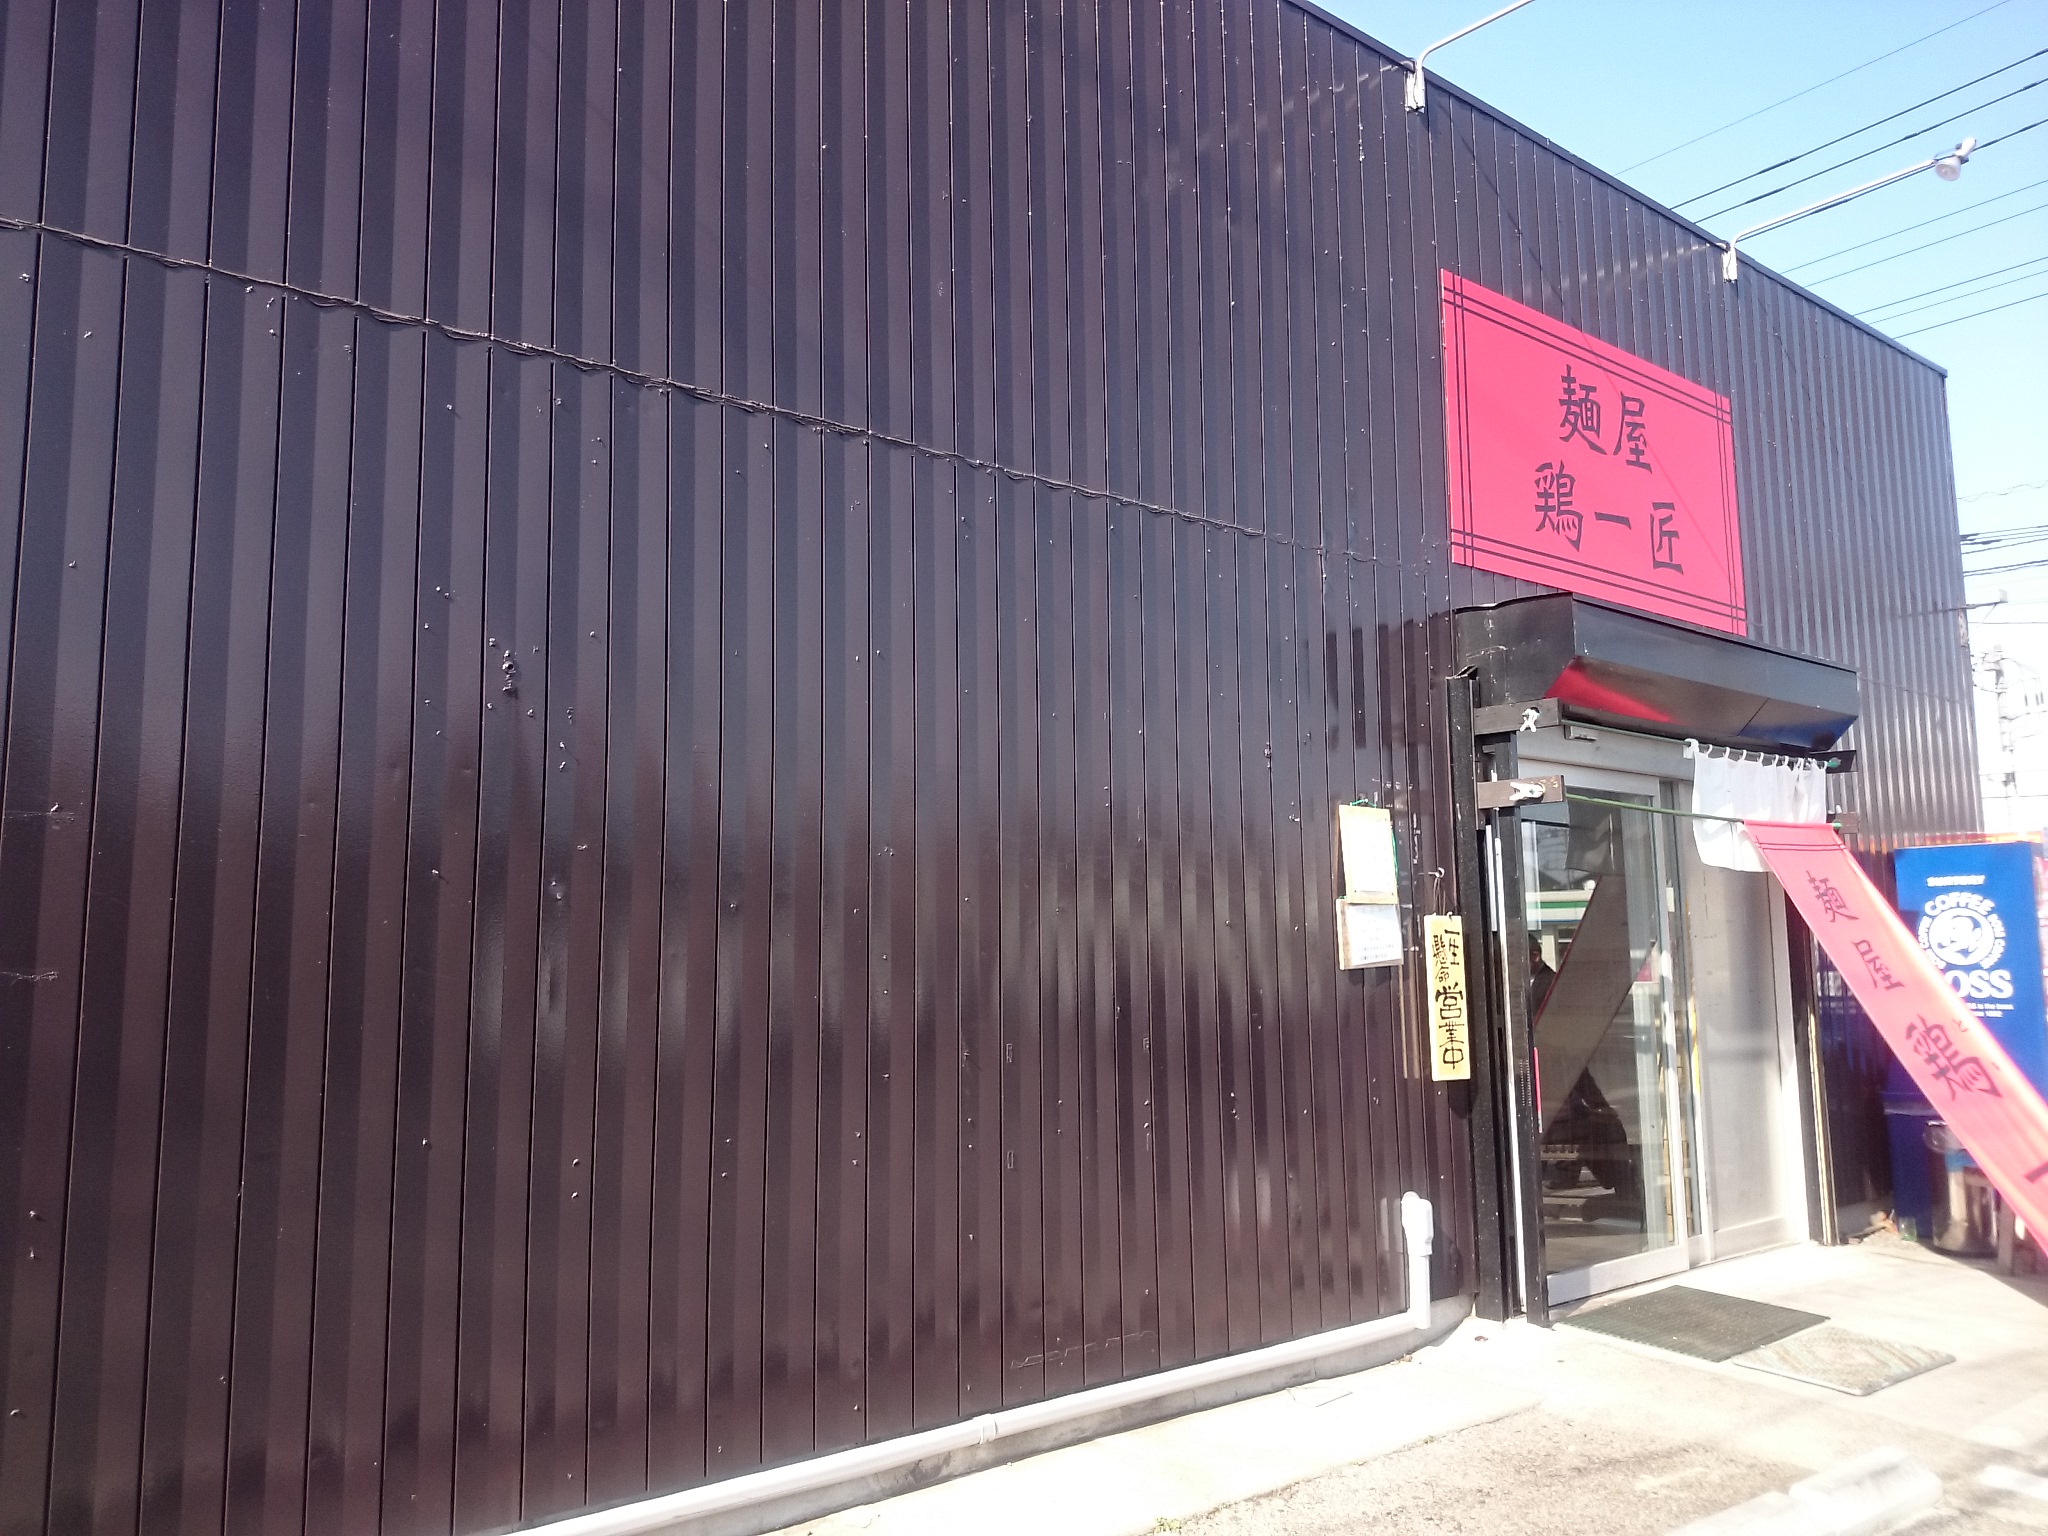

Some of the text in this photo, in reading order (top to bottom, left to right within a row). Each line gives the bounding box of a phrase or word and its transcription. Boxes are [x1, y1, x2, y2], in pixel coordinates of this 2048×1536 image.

[1558, 364, 1653, 474] 麺屋
[1533, 460, 1684, 575] 鶏一匠
[1924, 891, 1995, 916] COFFEE
[1944, 969, 2014, 999] OSS
